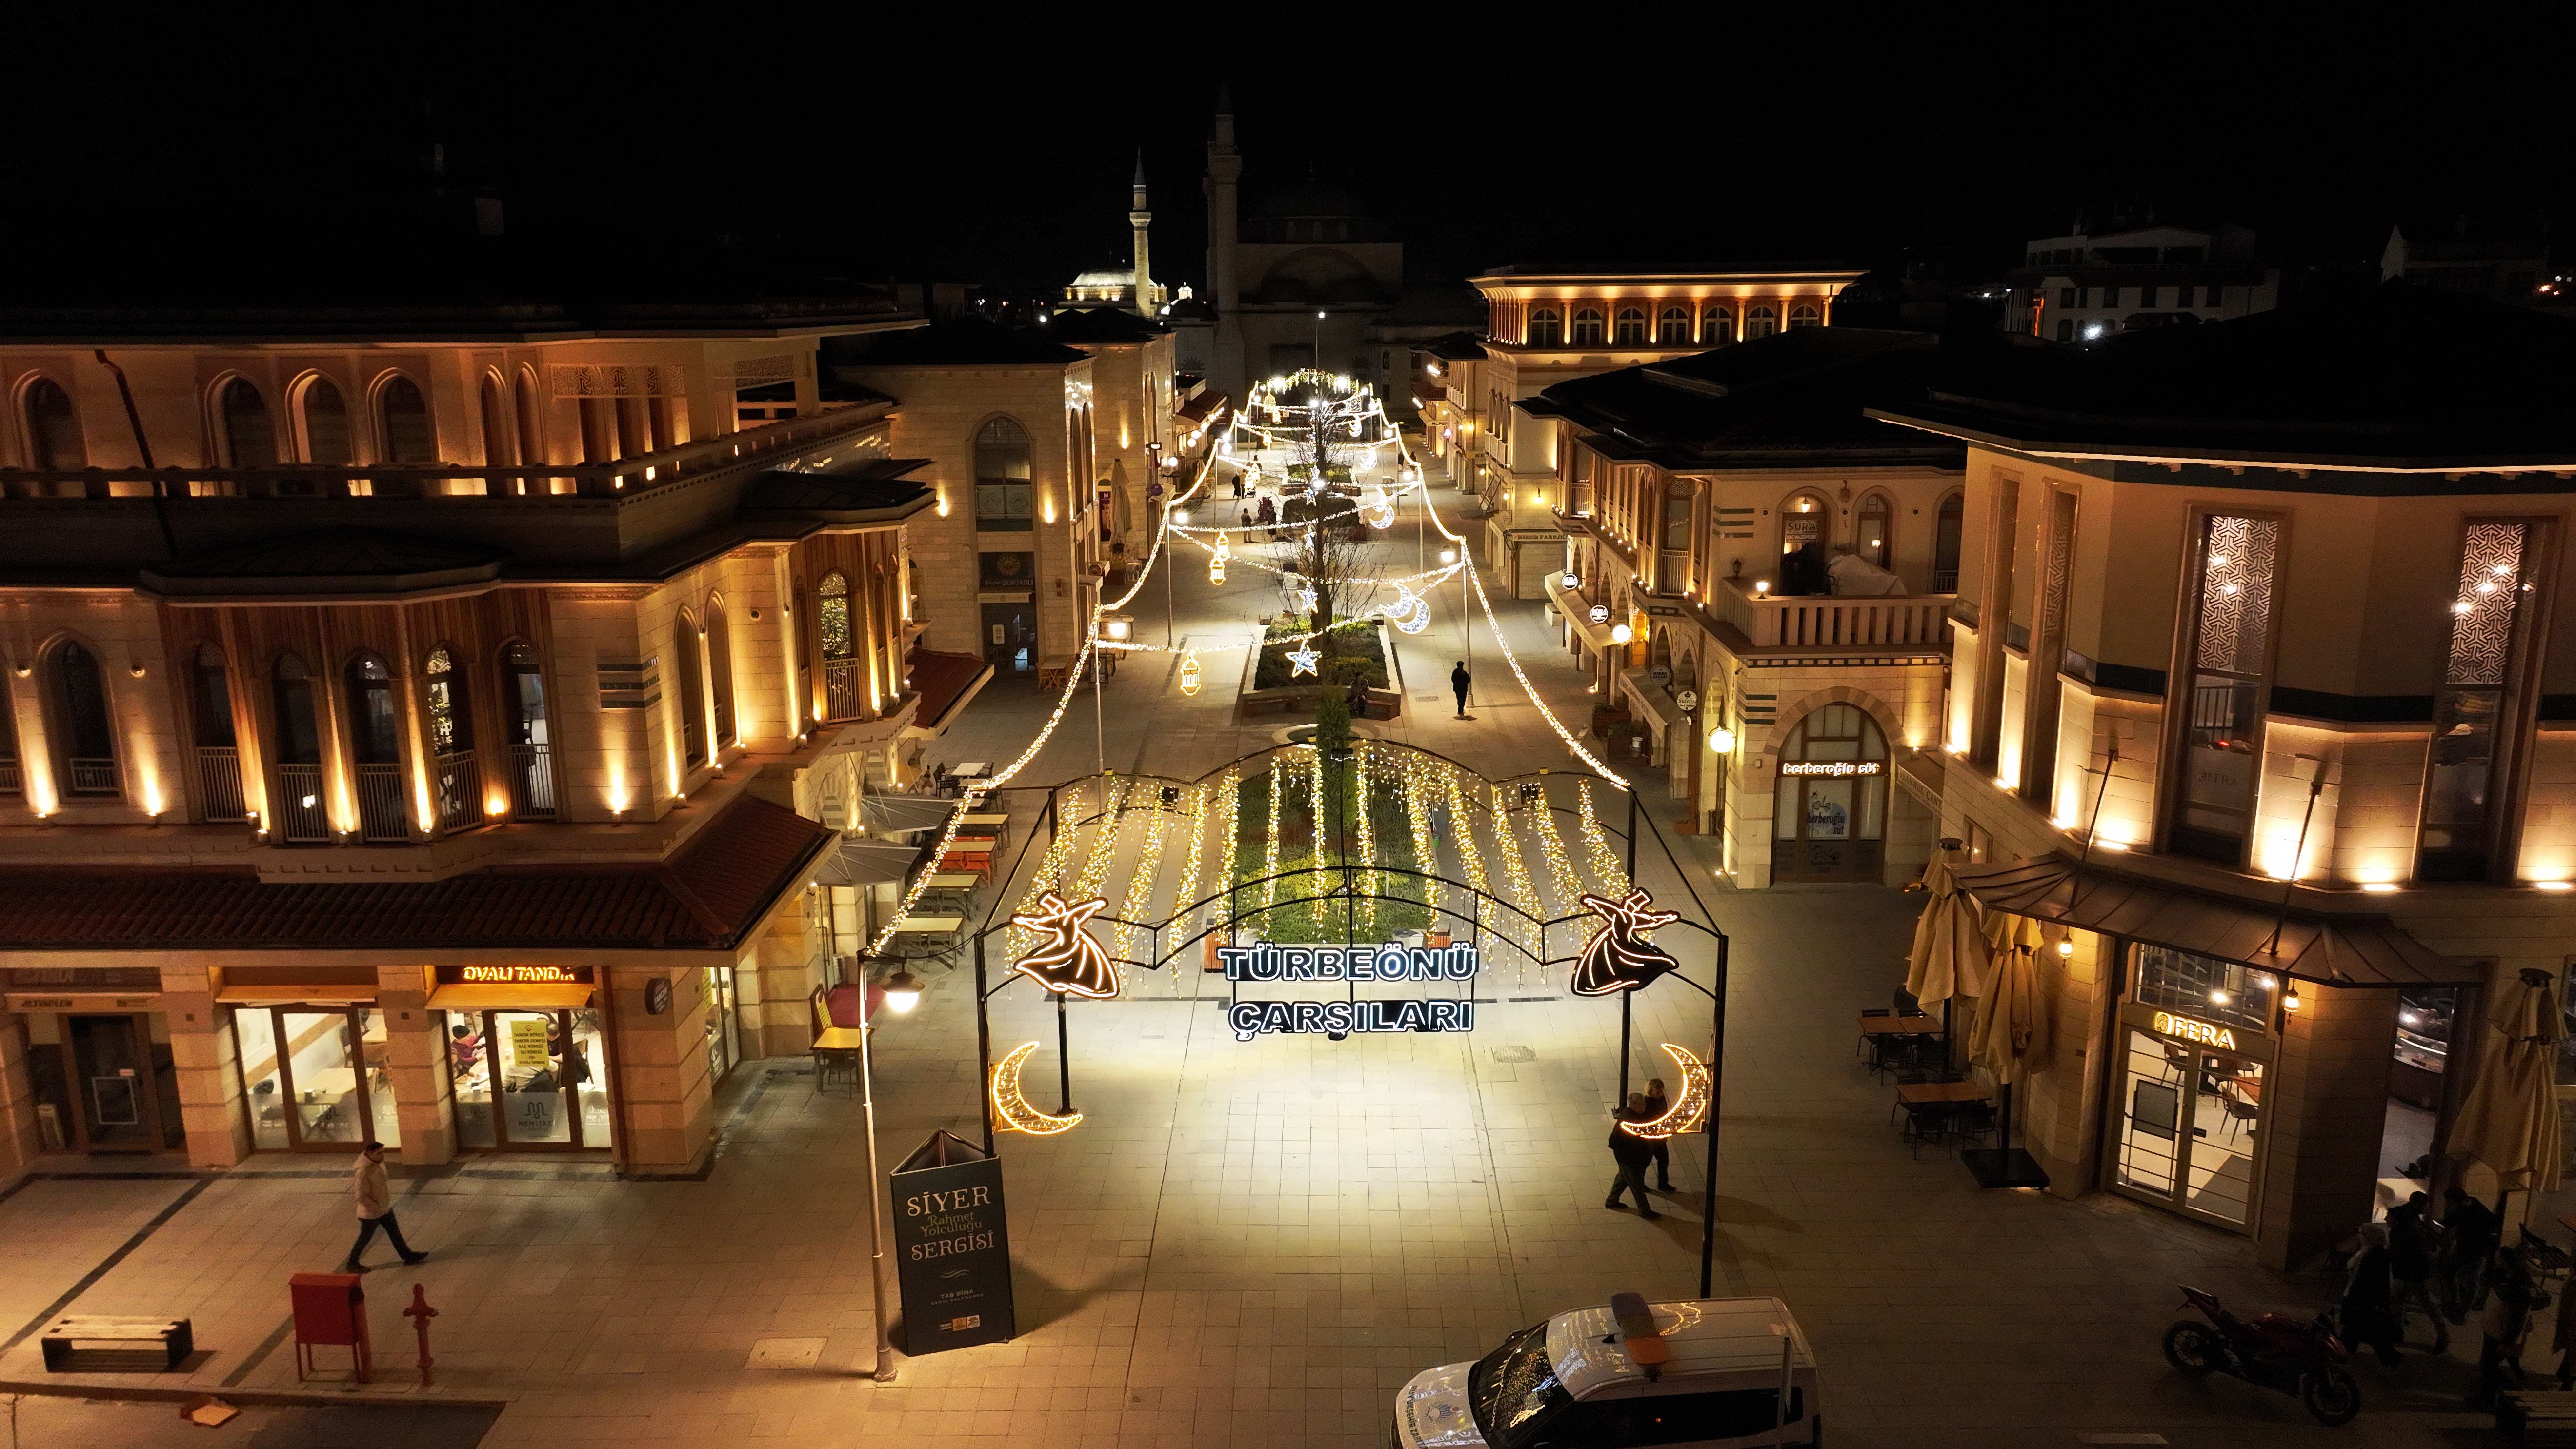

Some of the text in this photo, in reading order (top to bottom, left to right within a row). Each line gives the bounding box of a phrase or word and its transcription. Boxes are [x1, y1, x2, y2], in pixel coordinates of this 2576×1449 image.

[1783, 762, 1880, 776] berberoğlu süt
[1217, 941, 1479, 981] TÜRBEÖNÜ
[464, 966, 513, 981] OVALI
[1229, 1001, 1473, 1041] ÇARŞILARI
[906, 1185, 991, 1217] SİYER
[920, 1220, 983, 1237] Yolculuğu
[928, 1211, 975, 1227] Rahmet
[911, 1229, 995, 1261] SERGİSİ
